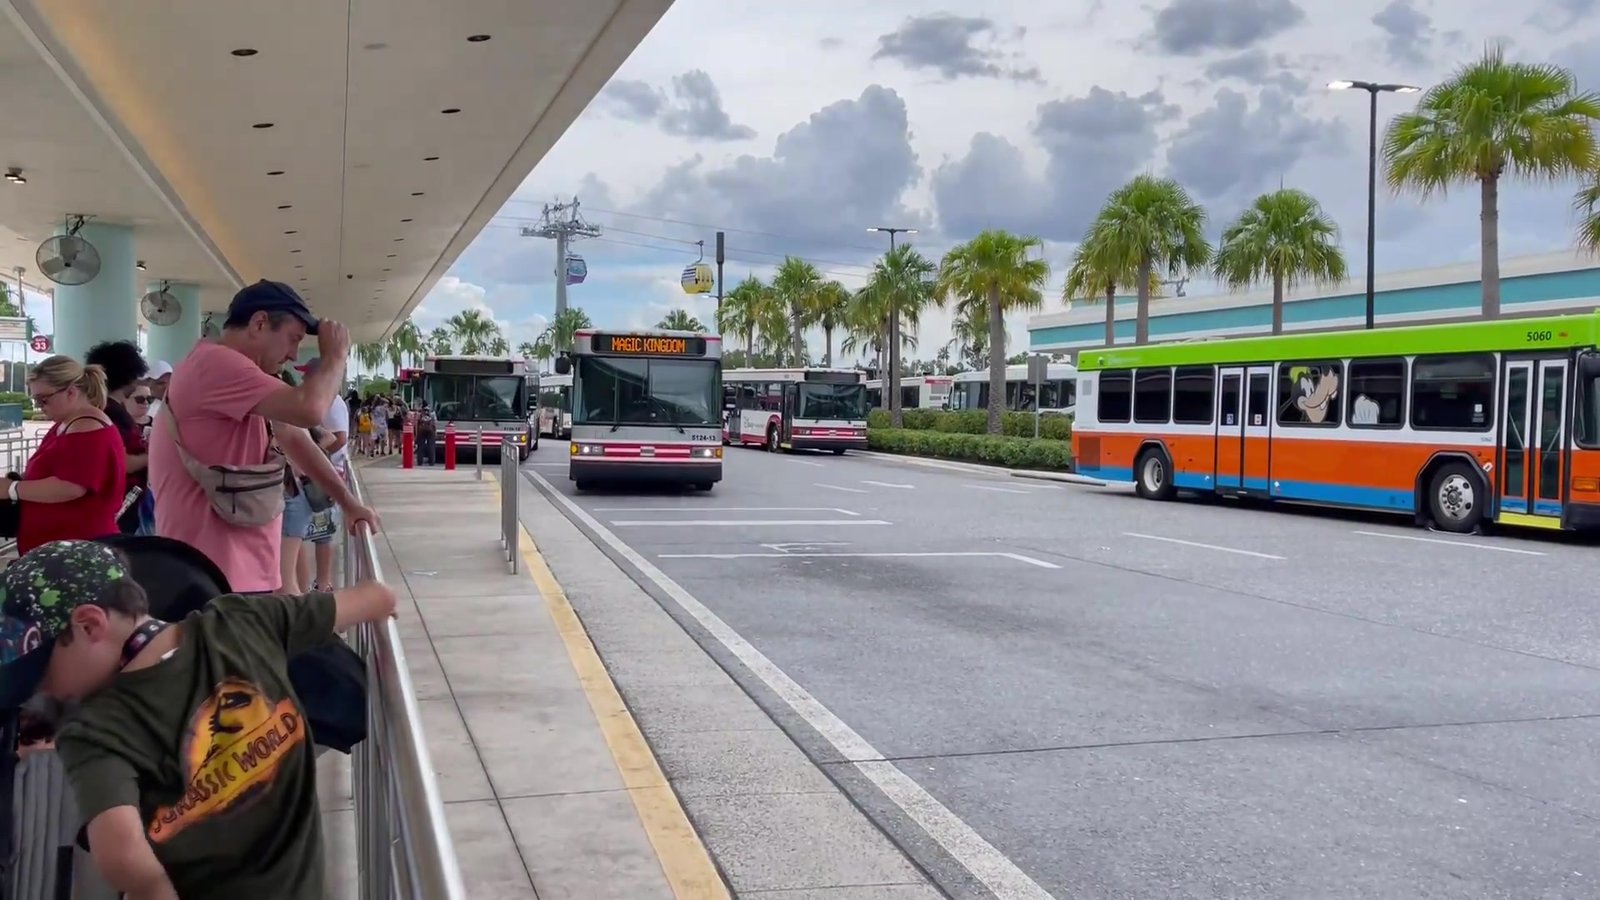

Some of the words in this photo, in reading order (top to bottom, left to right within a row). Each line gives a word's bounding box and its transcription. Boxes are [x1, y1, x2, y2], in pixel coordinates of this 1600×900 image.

[1526, 330, 1552, 342] 5060
[34, 341, 46, 350] 33
[611, 337, 642, 352] MAGIC
[643, 338, 686, 353] KINGDOM
[231, 712, 298, 773] WORLD
